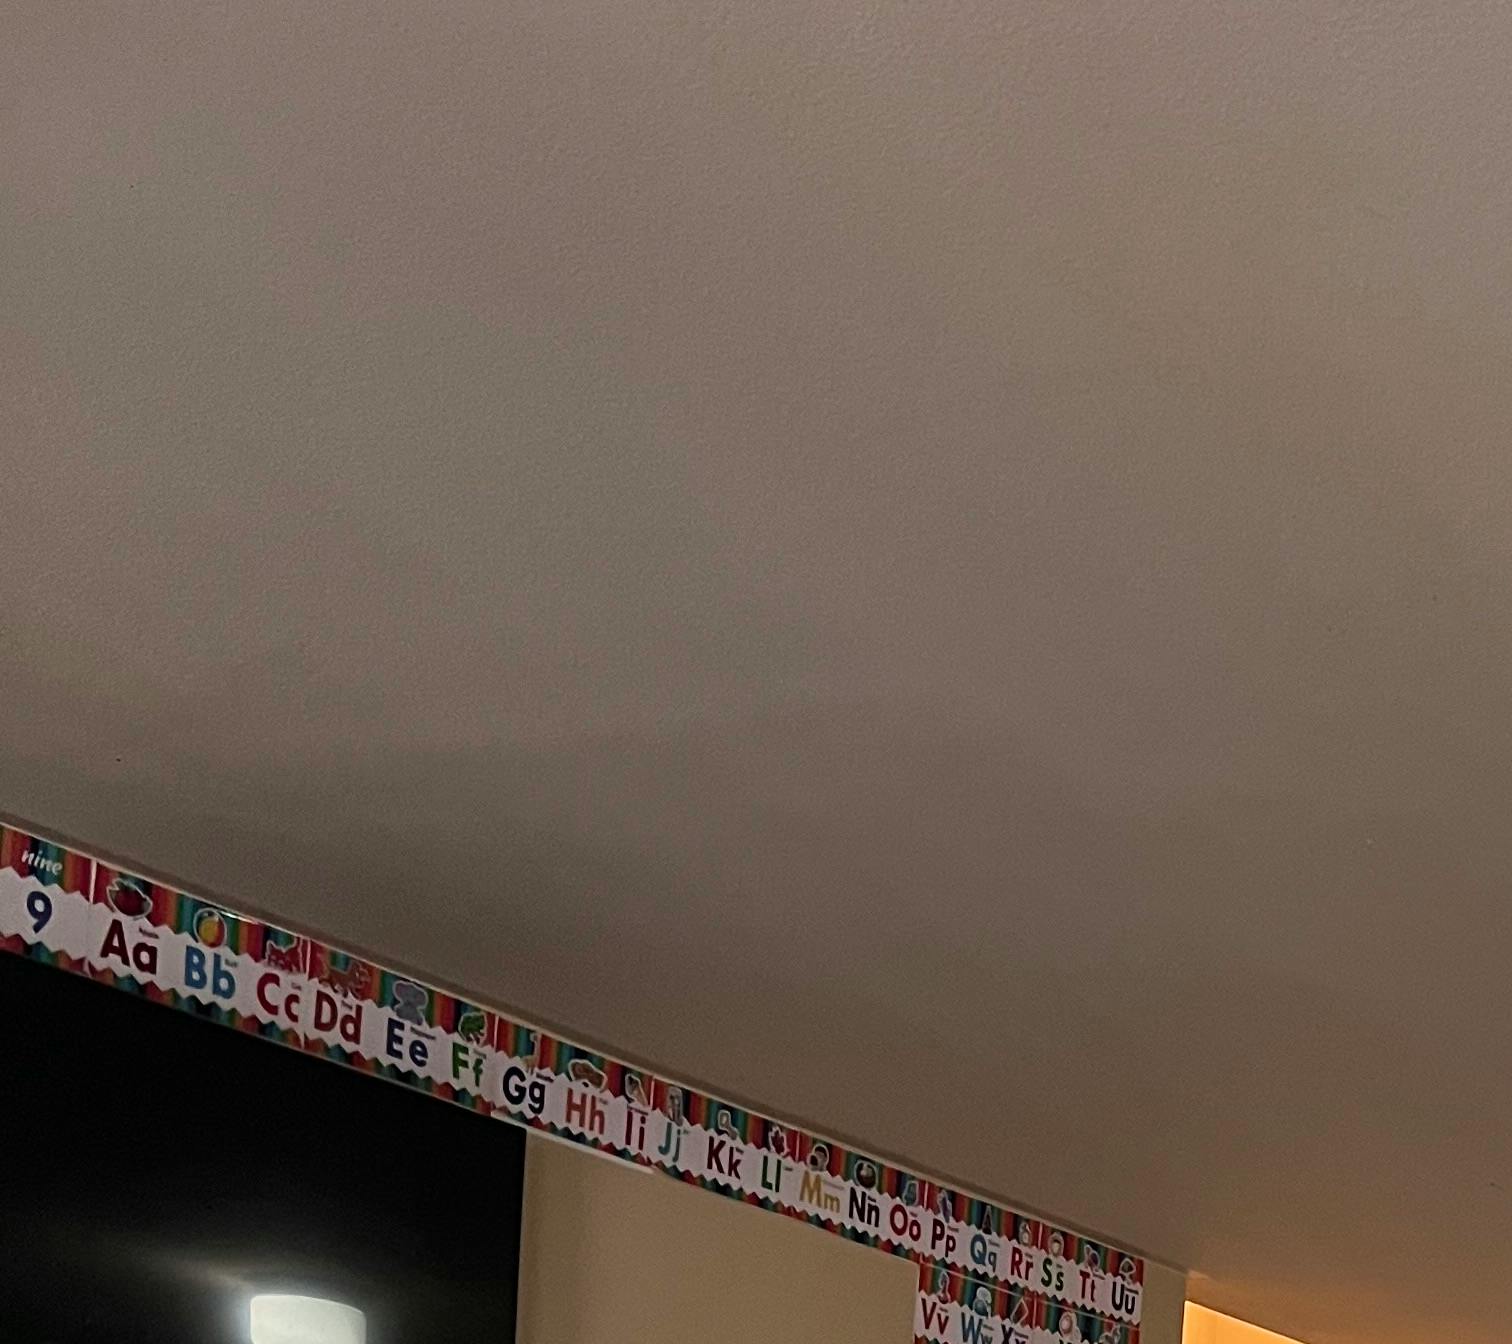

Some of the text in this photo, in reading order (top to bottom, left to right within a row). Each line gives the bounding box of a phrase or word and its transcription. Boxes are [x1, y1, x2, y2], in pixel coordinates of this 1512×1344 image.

[21, 849, 63, 877] nine
[26, 891, 1136, 1315] 9 Aa Bb Cc Dd Ee Ff Gg Hh Ii Jj Kk Ll Mm Nn Oo Pp Qq Rr Ss Tt Uu
[921, 1299, 950, 1336] Vv
